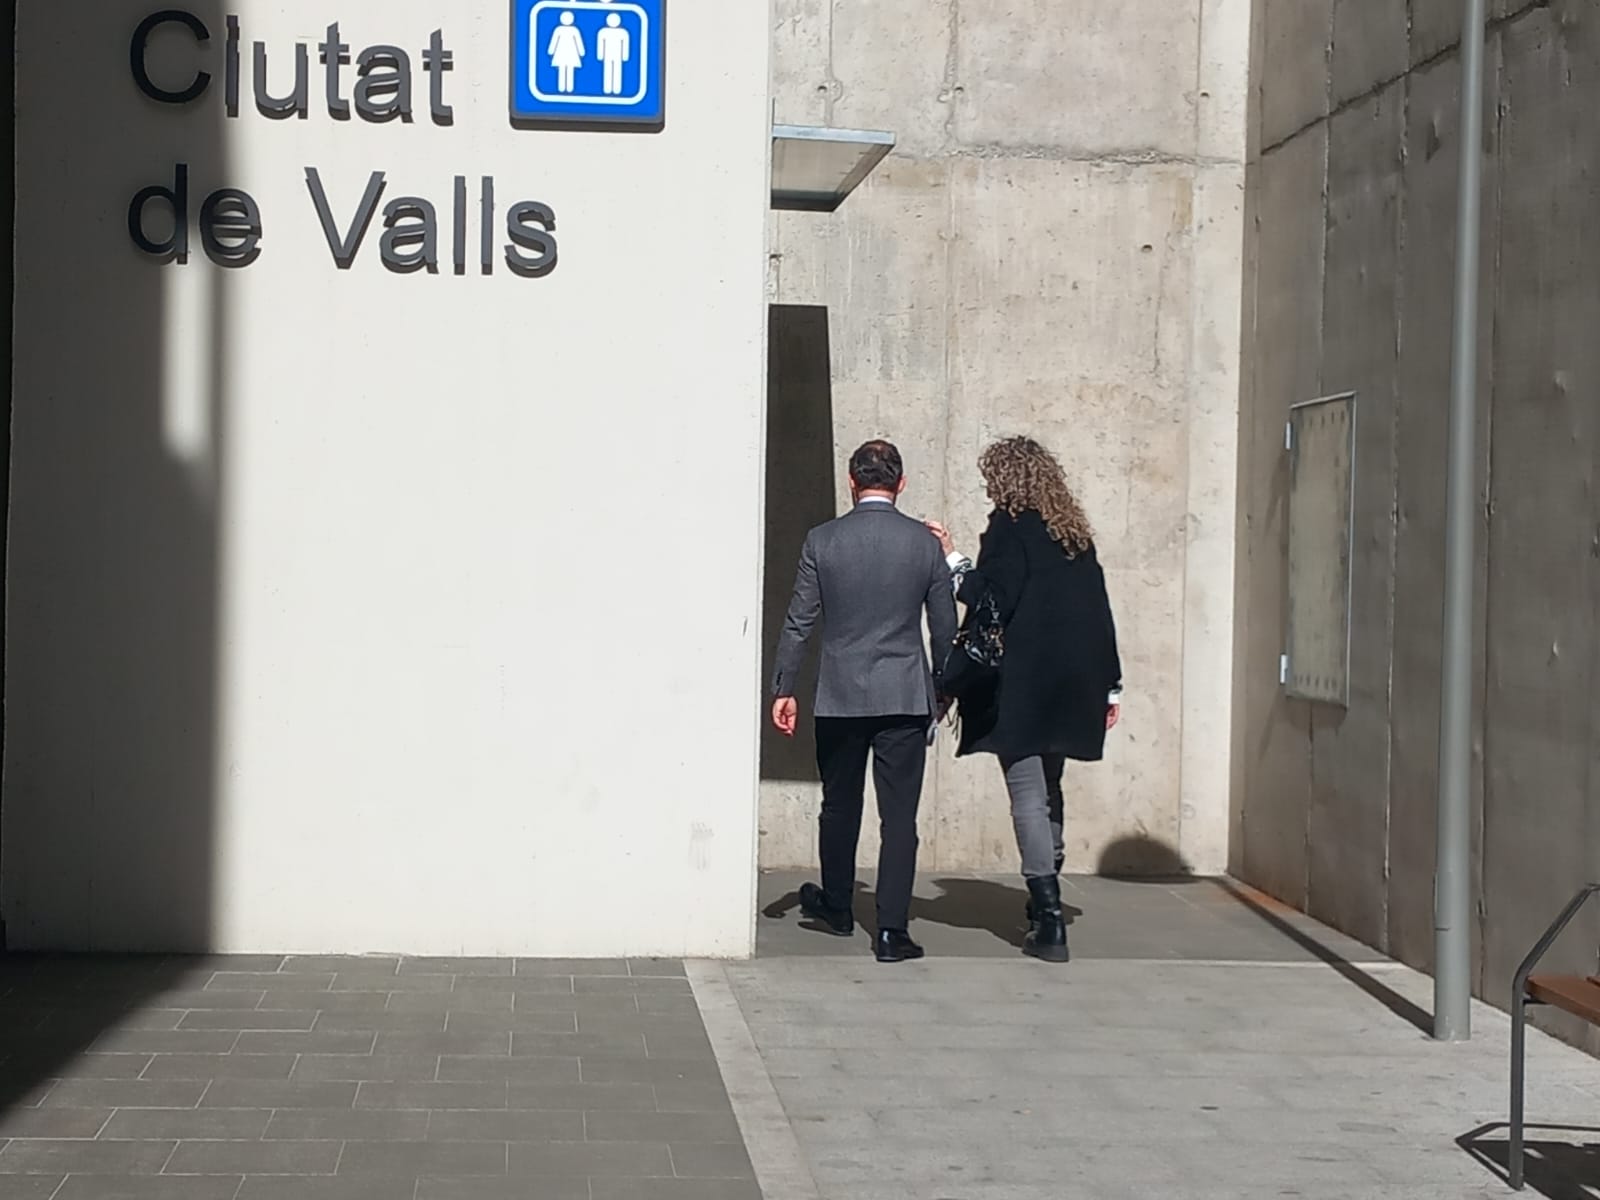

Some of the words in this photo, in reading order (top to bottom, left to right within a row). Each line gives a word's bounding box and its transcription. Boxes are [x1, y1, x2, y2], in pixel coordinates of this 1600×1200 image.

[130, 10, 454, 125] Ciutat
[128, 164, 262, 268] de
[304, 167, 558, 277] Valls
